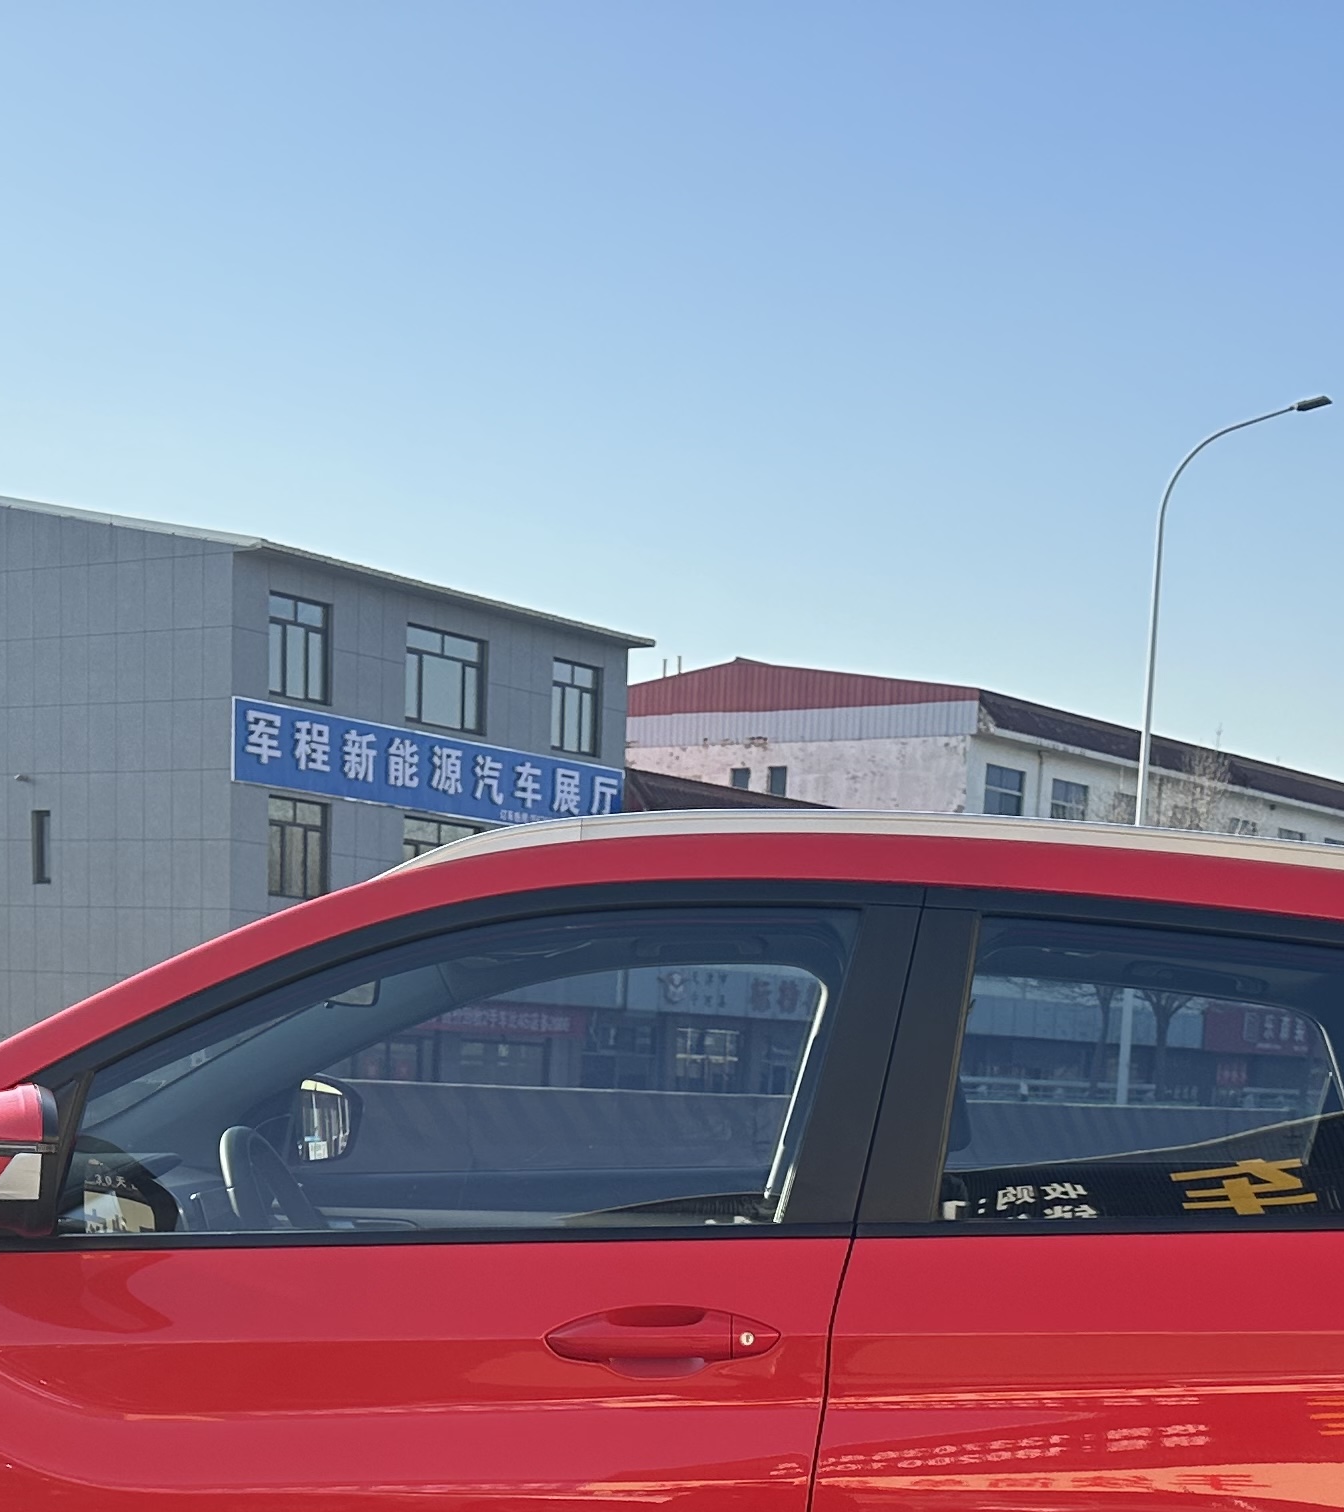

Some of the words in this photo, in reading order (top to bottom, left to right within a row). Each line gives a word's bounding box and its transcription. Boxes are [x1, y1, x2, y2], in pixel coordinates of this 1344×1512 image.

[244, 708, 620, 817] 军程新能源汽车展厅
